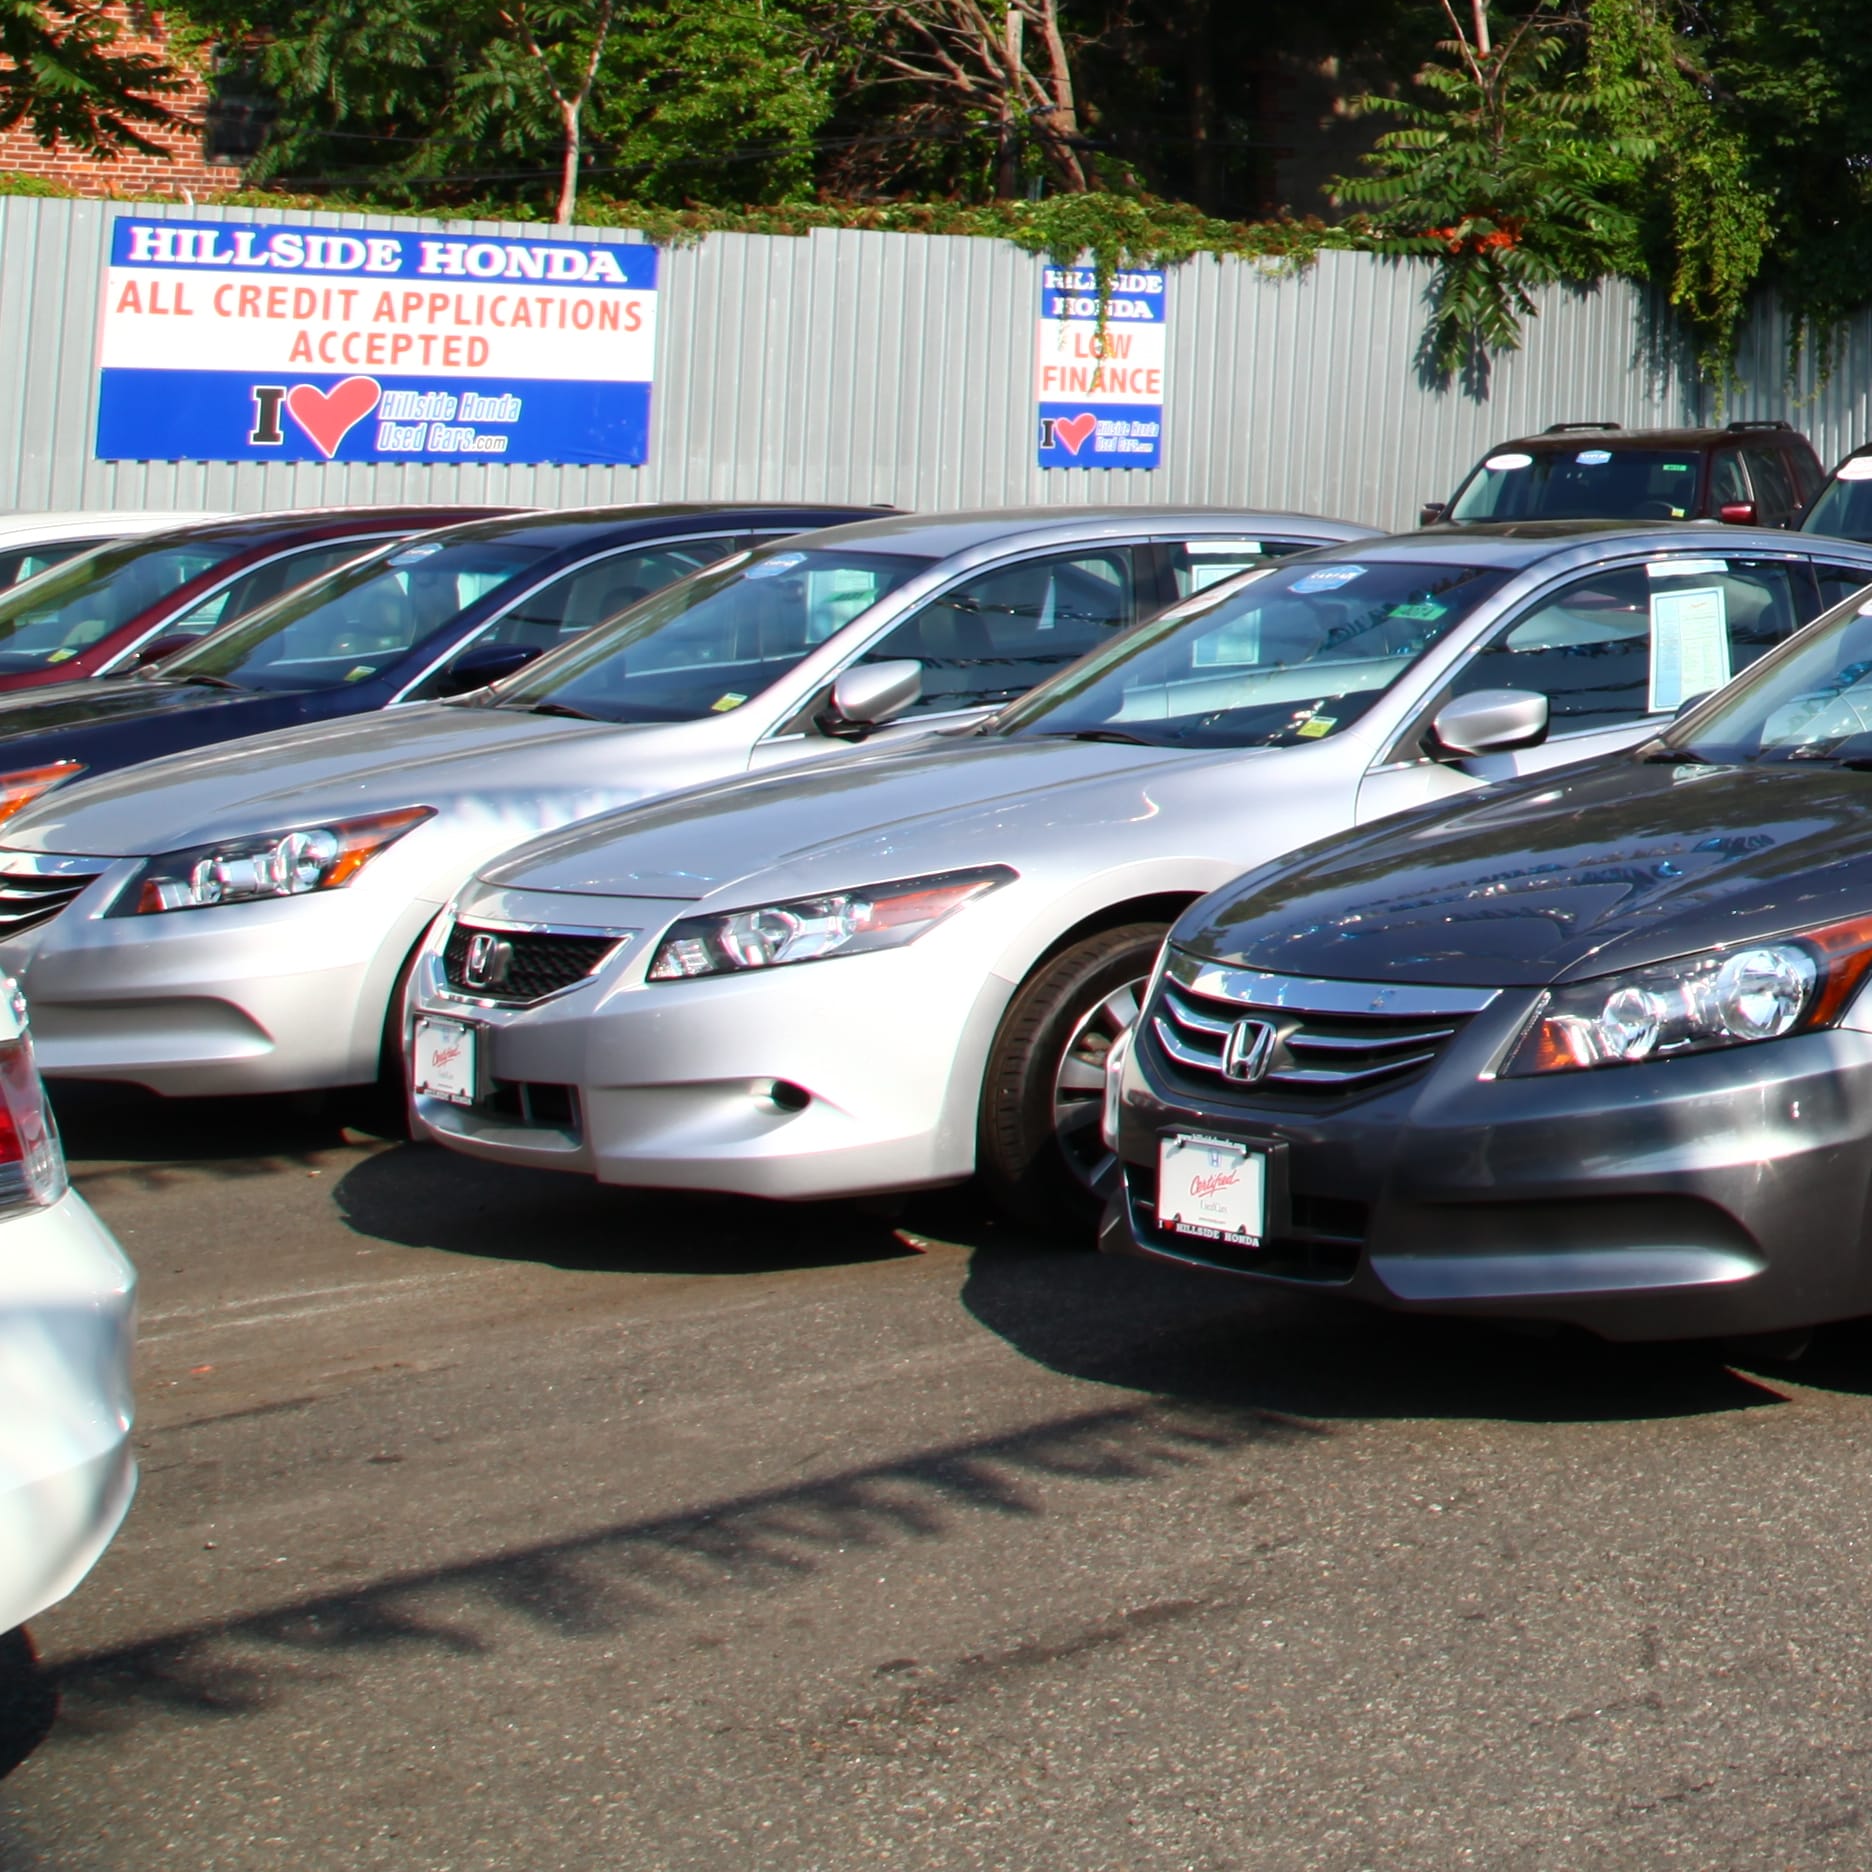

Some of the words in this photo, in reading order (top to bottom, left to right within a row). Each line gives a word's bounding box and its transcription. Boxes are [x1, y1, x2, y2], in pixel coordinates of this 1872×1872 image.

[129, 226, 402, 273] HILLSIDE
[418, 241, 628, 282] HONDA
[116, 280, 193, 315] ALL
[213, 283, 359, 321] CREDIT
[372, 291, 642, 332] APPLICATIONS
[288, 330, 490, 367] ACCEPTED
[1074, 333, 1133, 359] LOW
[1043, 366, 1160, 394] FINANCE
[250, 386, 286, 444] I
[378, 390, 457, 421] Hillside
[458, 392, 521, 422] Honda
[377, 422, 427, 451] Used
[1224, 1231, 1260, 1247] HONDA
